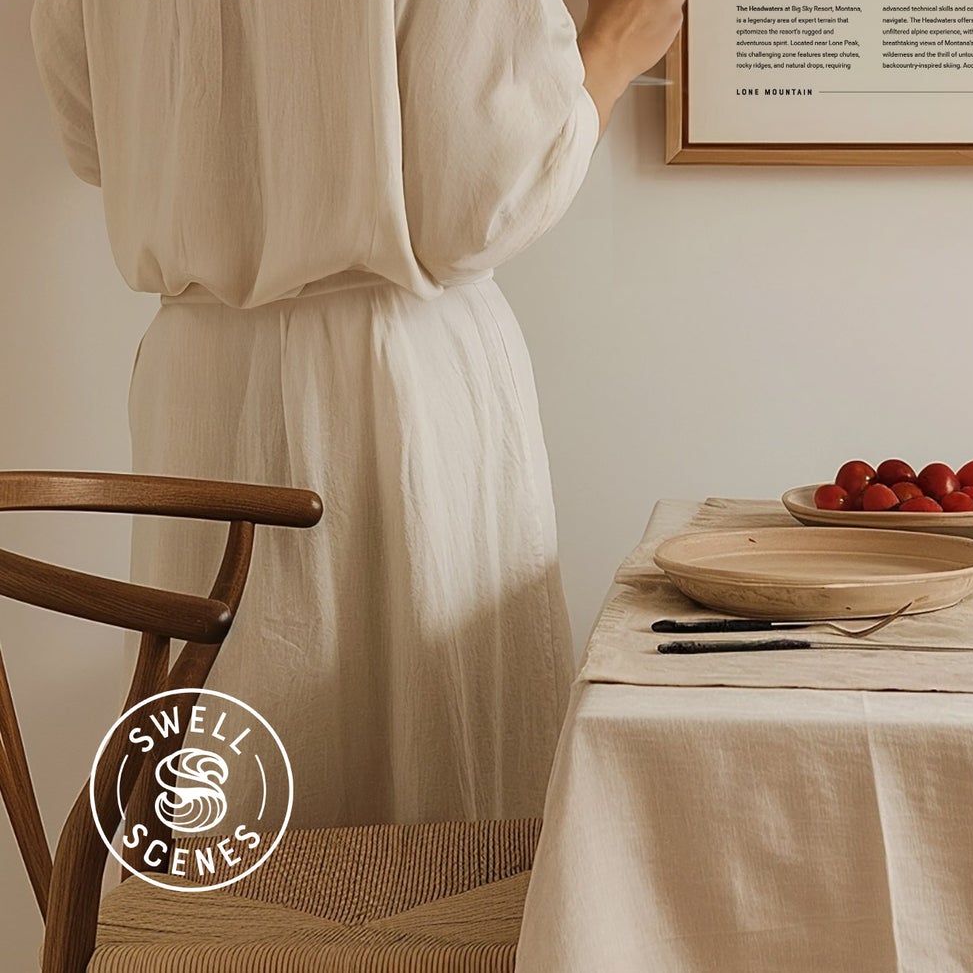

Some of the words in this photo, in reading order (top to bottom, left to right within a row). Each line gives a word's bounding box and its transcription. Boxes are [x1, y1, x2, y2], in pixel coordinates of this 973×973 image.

[747, 17, 776, 25] legendary
[798, 17, 816, 25] expert
[882, 17, 908, 25] navigate.
[736, 28, 768, 36] epitomizes
[802, 28, 822, 36] rugged
[910, 28, 928, 36] alpine
[929, 28, 962, 36] experience,
[748, 51, 781, 59] challenging
[822, 51, 838, 59] steep
[839, 51, 860, 59] chutes,
[736, 62, 752, 70] rocky
[753, 62, 772, 70] ridges,
[806, 62, 824, 70] drops,
[825, 62, 851, 70] requiring
[882, 62, 942, 70] backcountry-inspired
[943, 62, 961, 70] skiing.
